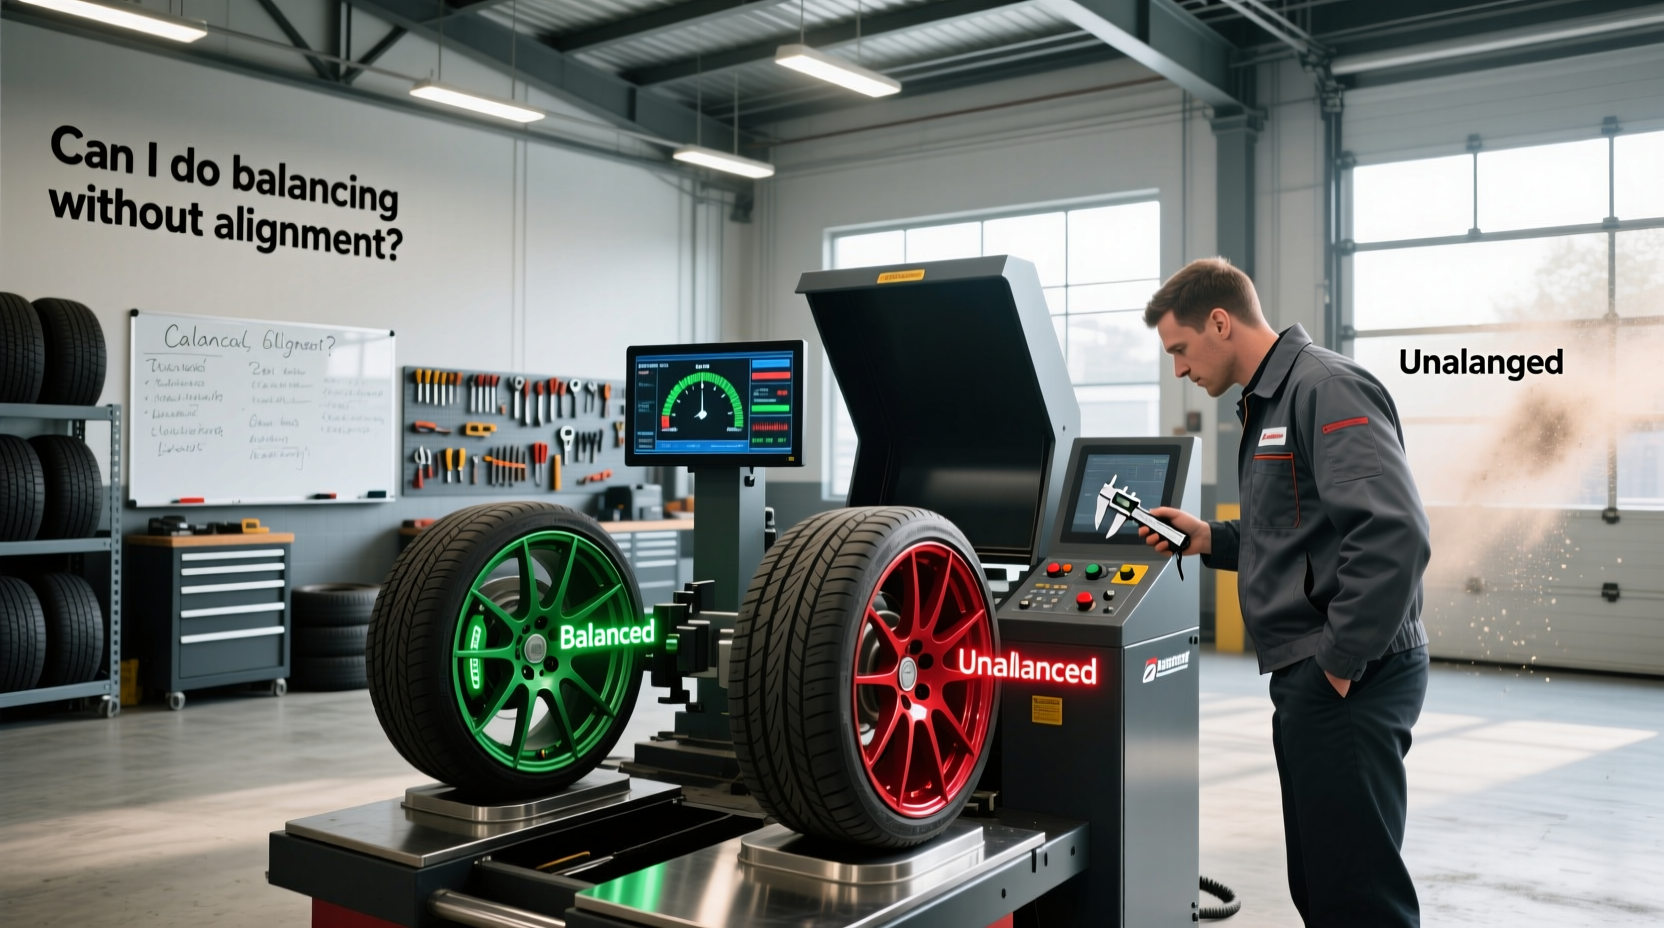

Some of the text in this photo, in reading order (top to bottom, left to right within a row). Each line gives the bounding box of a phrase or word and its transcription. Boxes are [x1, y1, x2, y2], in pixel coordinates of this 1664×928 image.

[50, 124, 399, 222] Can I do balancing
[48, 183, 404, 261] without alignment?
